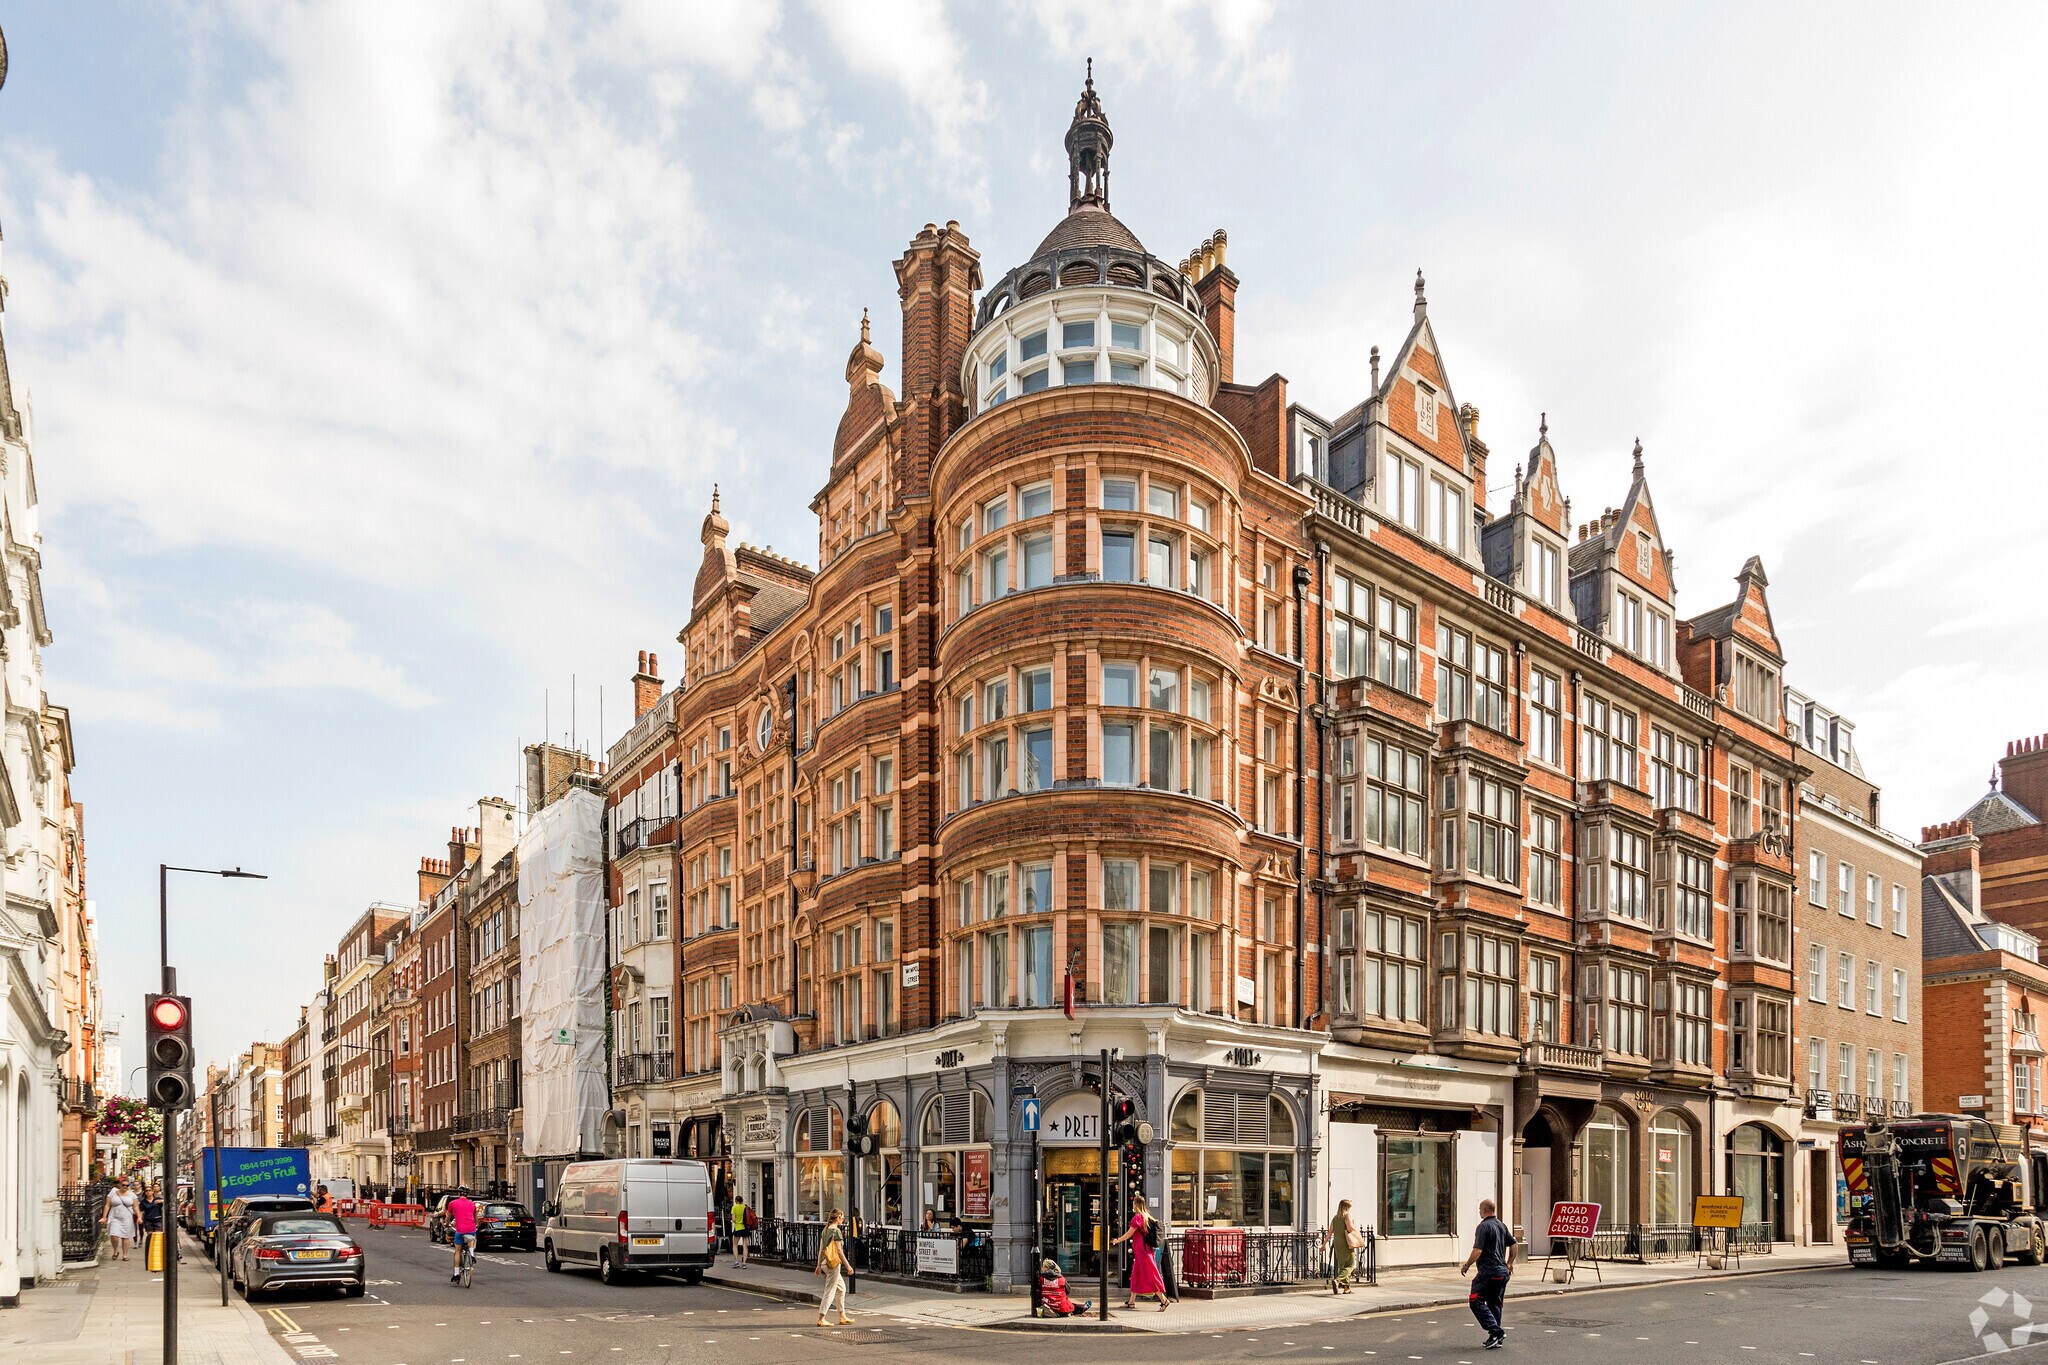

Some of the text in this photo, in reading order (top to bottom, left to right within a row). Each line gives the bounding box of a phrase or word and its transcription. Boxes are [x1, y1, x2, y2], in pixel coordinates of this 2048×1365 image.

[941, 1050, 958, 1068] PRET
[1234, 1047, 1254, 1067] PRET
[1635, 1090, 1654, 1101] SOLO
[1064, 1115, 1099, 1138] PRET
[1894, 1136, 1947, 1147] CONCRETE
[1659, 1152, 1672, 1161] SALE
[240, 1161, 259, 1171] 0844
[260, 1159, 274, 1168] 579
[273, 1165, 298, 1179] Fruit
[751, 1182, 756, 1190] 3
[995, 1197, 1009, 1208] 24
[1560, 1206, 1588, 1215] ROAD
[1555, 1215, 1589, 1224] AHEAD
[1551, 1224, 1589, 1234] CLOSED
